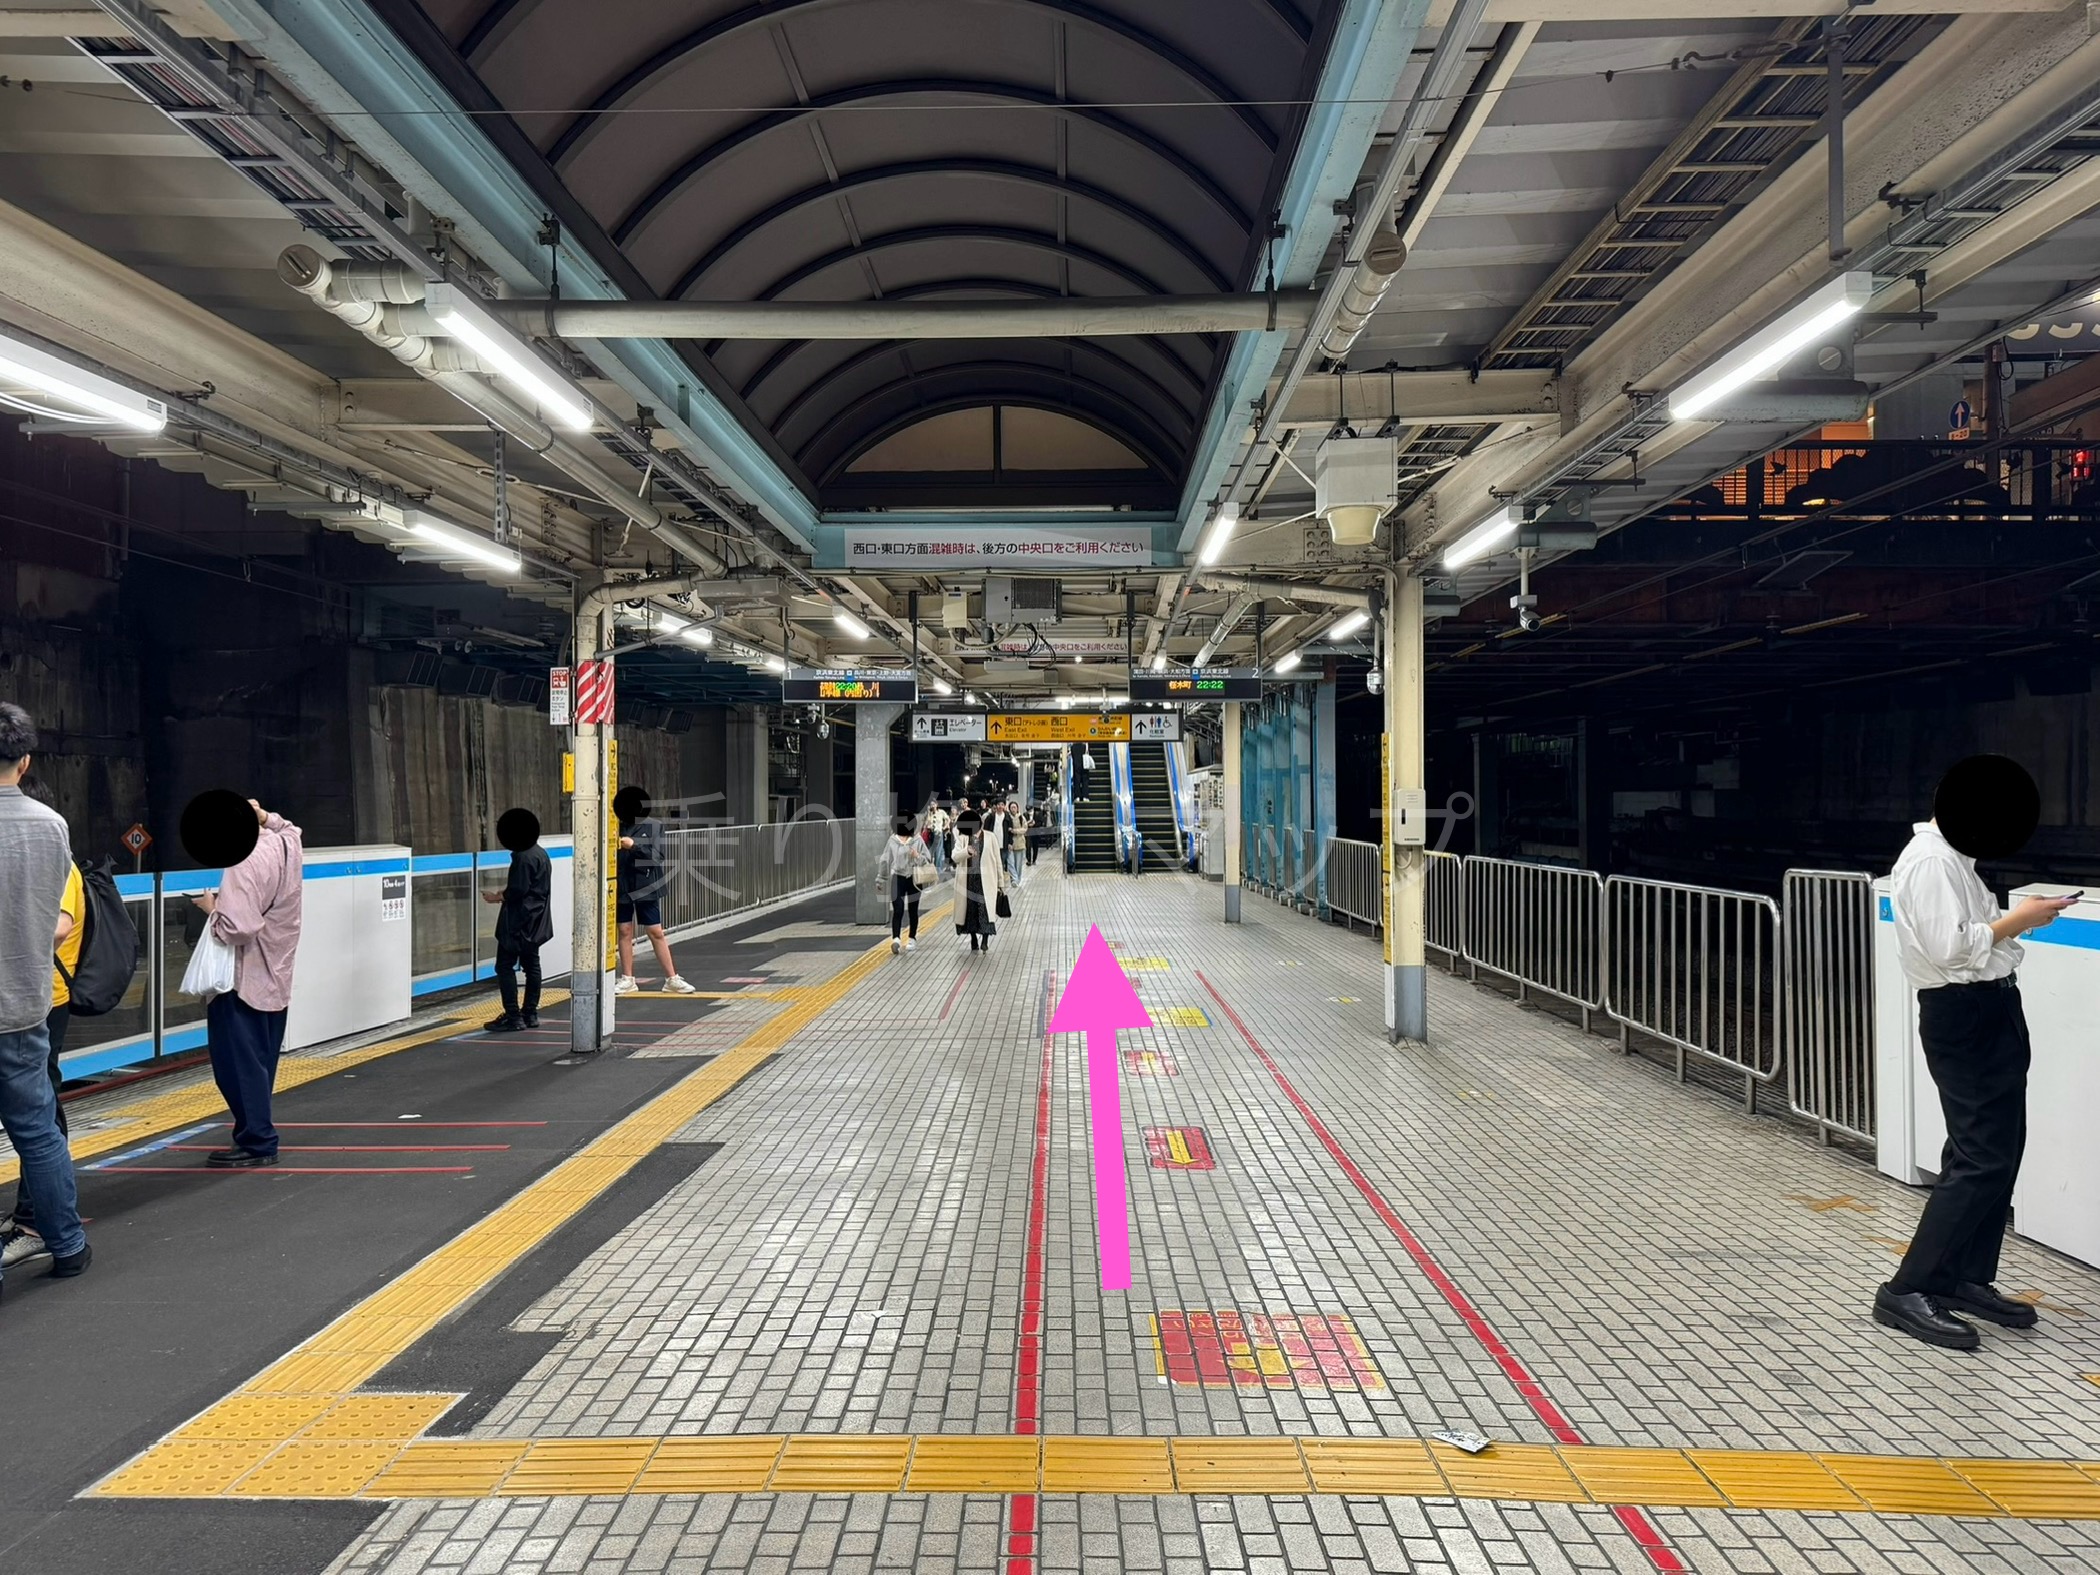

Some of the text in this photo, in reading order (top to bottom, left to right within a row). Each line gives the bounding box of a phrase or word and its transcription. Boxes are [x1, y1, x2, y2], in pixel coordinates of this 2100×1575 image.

[853, 542, 1144, 555] 西口・東口方面混雑時は、後方の中央口をご利用ください
[1251, 667, 1260, 679] 2
[1168, 680, 1223, 690] 桜木町 22:22
[949, 718, 982, 727] エレベーター
[1004, 716, 1022, 726] 東口
[1051, 716, 1068, 726] 西口
[131, 833, 142, 845] 10
